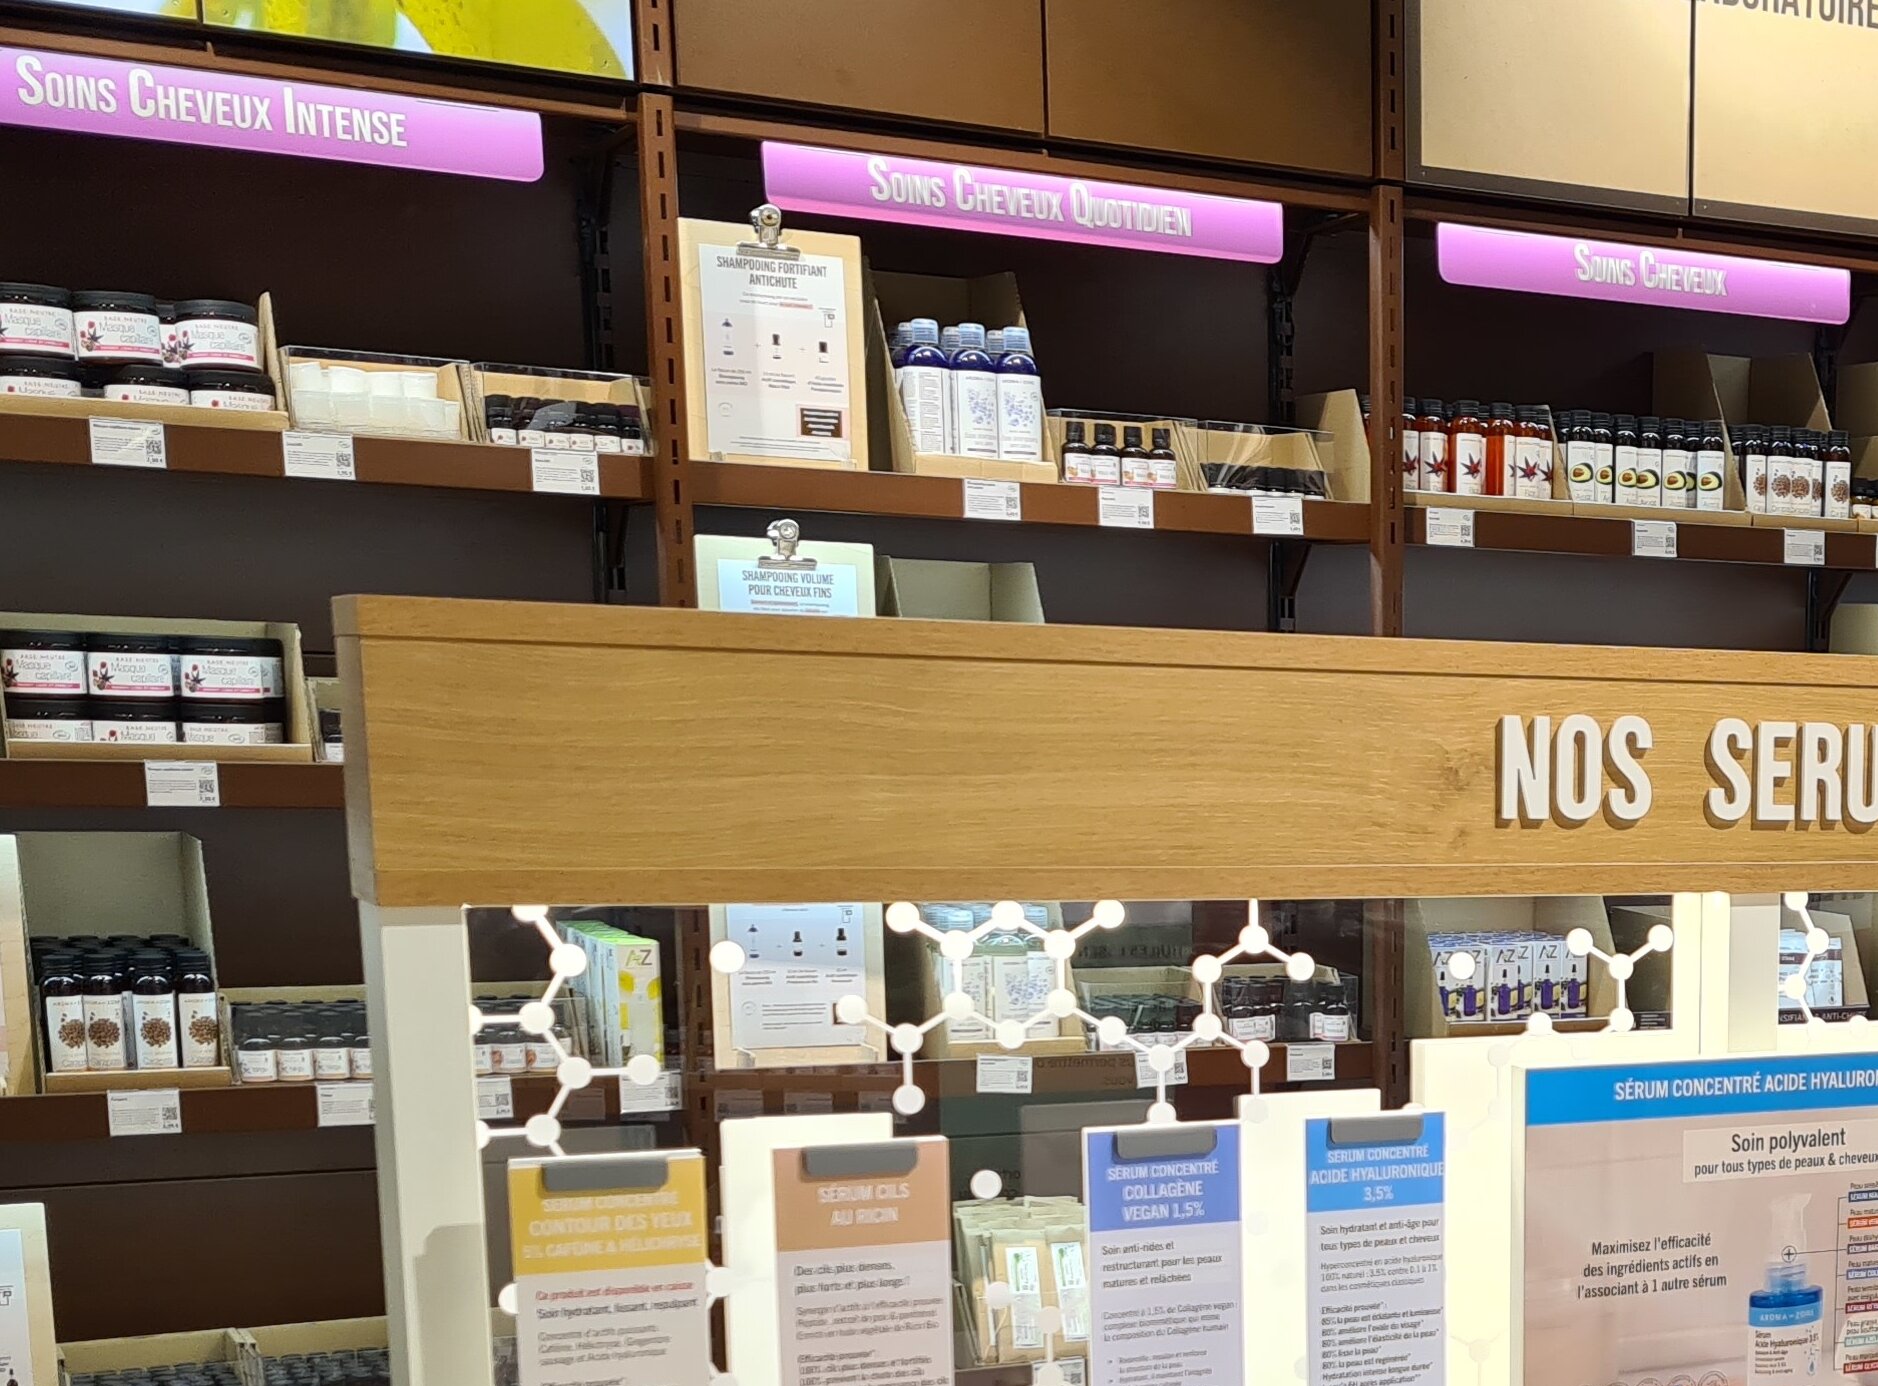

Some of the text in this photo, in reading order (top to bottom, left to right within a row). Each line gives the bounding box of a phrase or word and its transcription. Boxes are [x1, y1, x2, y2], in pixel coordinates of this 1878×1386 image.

[16, 55, 408, 147] SOINS CHEVEUX INTENSE
[868, 155, 1192, 238] SOINS CHEVEUX QUOTIDIEN
[716, 256, 827, 277] SHAMPOOING FORTIFIANT
[1573, 242, 1728, 296] SOINS CHEVEUX
[749, 274, 798, 289] ANTICHUTE
[742, 570, 834, 585] SHAMPOOING VOLUME
[748, 584, 832, 598] POUR CHEVEUX FINS
[1497, 713, 1655, 823] NOS
[1614, 1071, 1669, 1102] SÉRUM
[1672, 1070, 1761, 1097] CONCENTRÉ
[1764, 1071, 1807, 1093] ACIDE
[1731, 1127, 1846, 1154] Soin polyvalent
[1368, 1145, 1429, 1161] CONCENTRÉ
[1311, 1162, 1444, 1185] ACIDE HYALURONIQUE
[1694, 1161, 1718, 1178] pour
[1721, 1159, 1744, 1174] tous
[1747, 1157, 1776, 1176] types
[1779, 1156, 1792, 1170] de
[1794, 1154, 1825, 1172] peaux
[1828, 1153, 1837, 1167] &
[1123, 1179, 1203, 1201] COLLAGÈNE
[1364, 1186, 1394, 1202] 3,5%
[1123, 1201, 1205, 1222] VEGAN 1,5%
[1320, 1219, 1439, 1235] Soin hydratant et anti-âge pour
[1166, 1241, 1174, 1251] et
[1340, 1240, 1361, 1251] types
[1363, 1239, 1373, 1248] de
[1399, 1235, 1407, 1245] et
[1409, 1234, 1439, 1244] cheveux
[1591, 1232, 1712, 1257] Maximisez l'efficacité
[1583, 1254, 1719, 1279] des ingrédients actifs en
[1577, 1273, 1727, 1299] l'associant à 1 autre sérum
